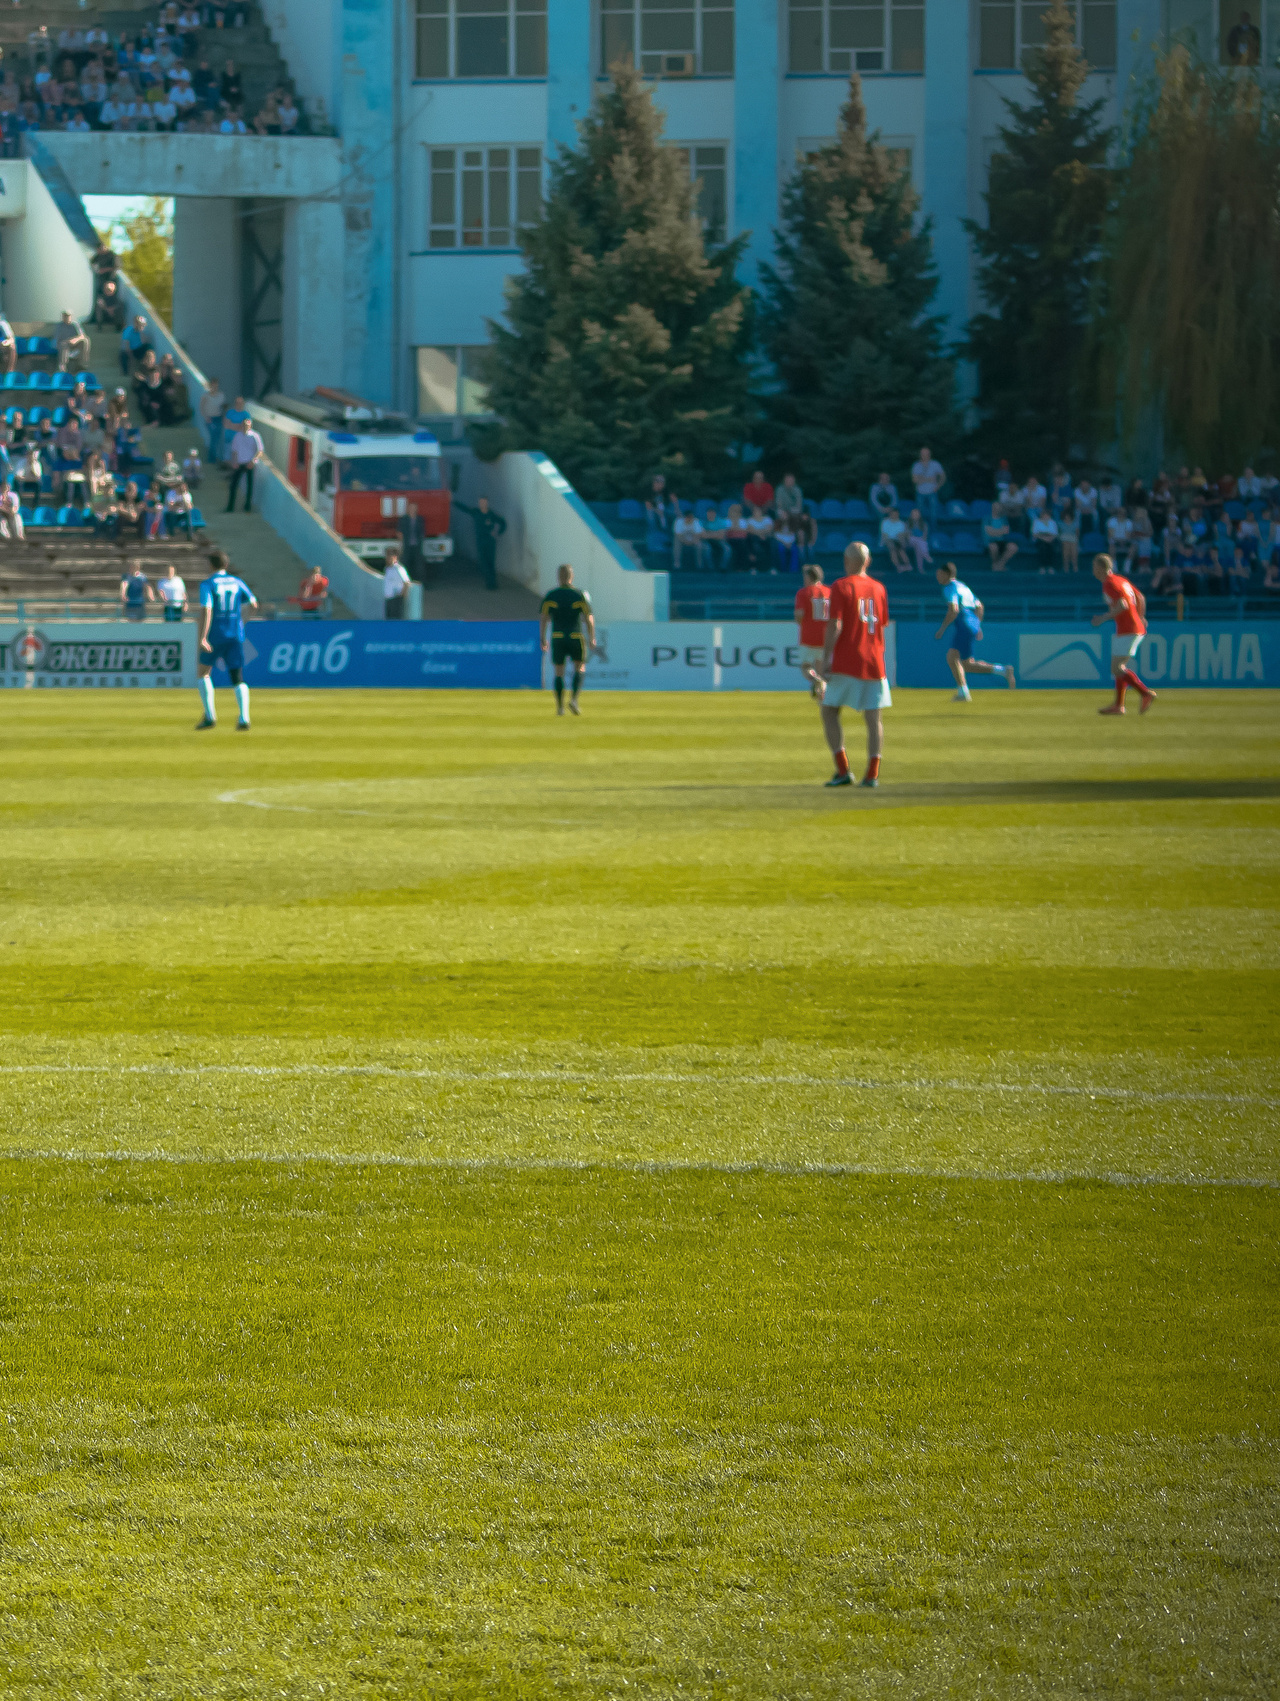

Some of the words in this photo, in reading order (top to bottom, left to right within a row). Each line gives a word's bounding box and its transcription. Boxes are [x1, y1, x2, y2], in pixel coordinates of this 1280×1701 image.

[858, 597, 878, 634] 4
[49, 645, 179, 670] ЭКСПРЕСС
[269, 631, 353, 674] впб
[652, 646, 802, 668] PEUGE
